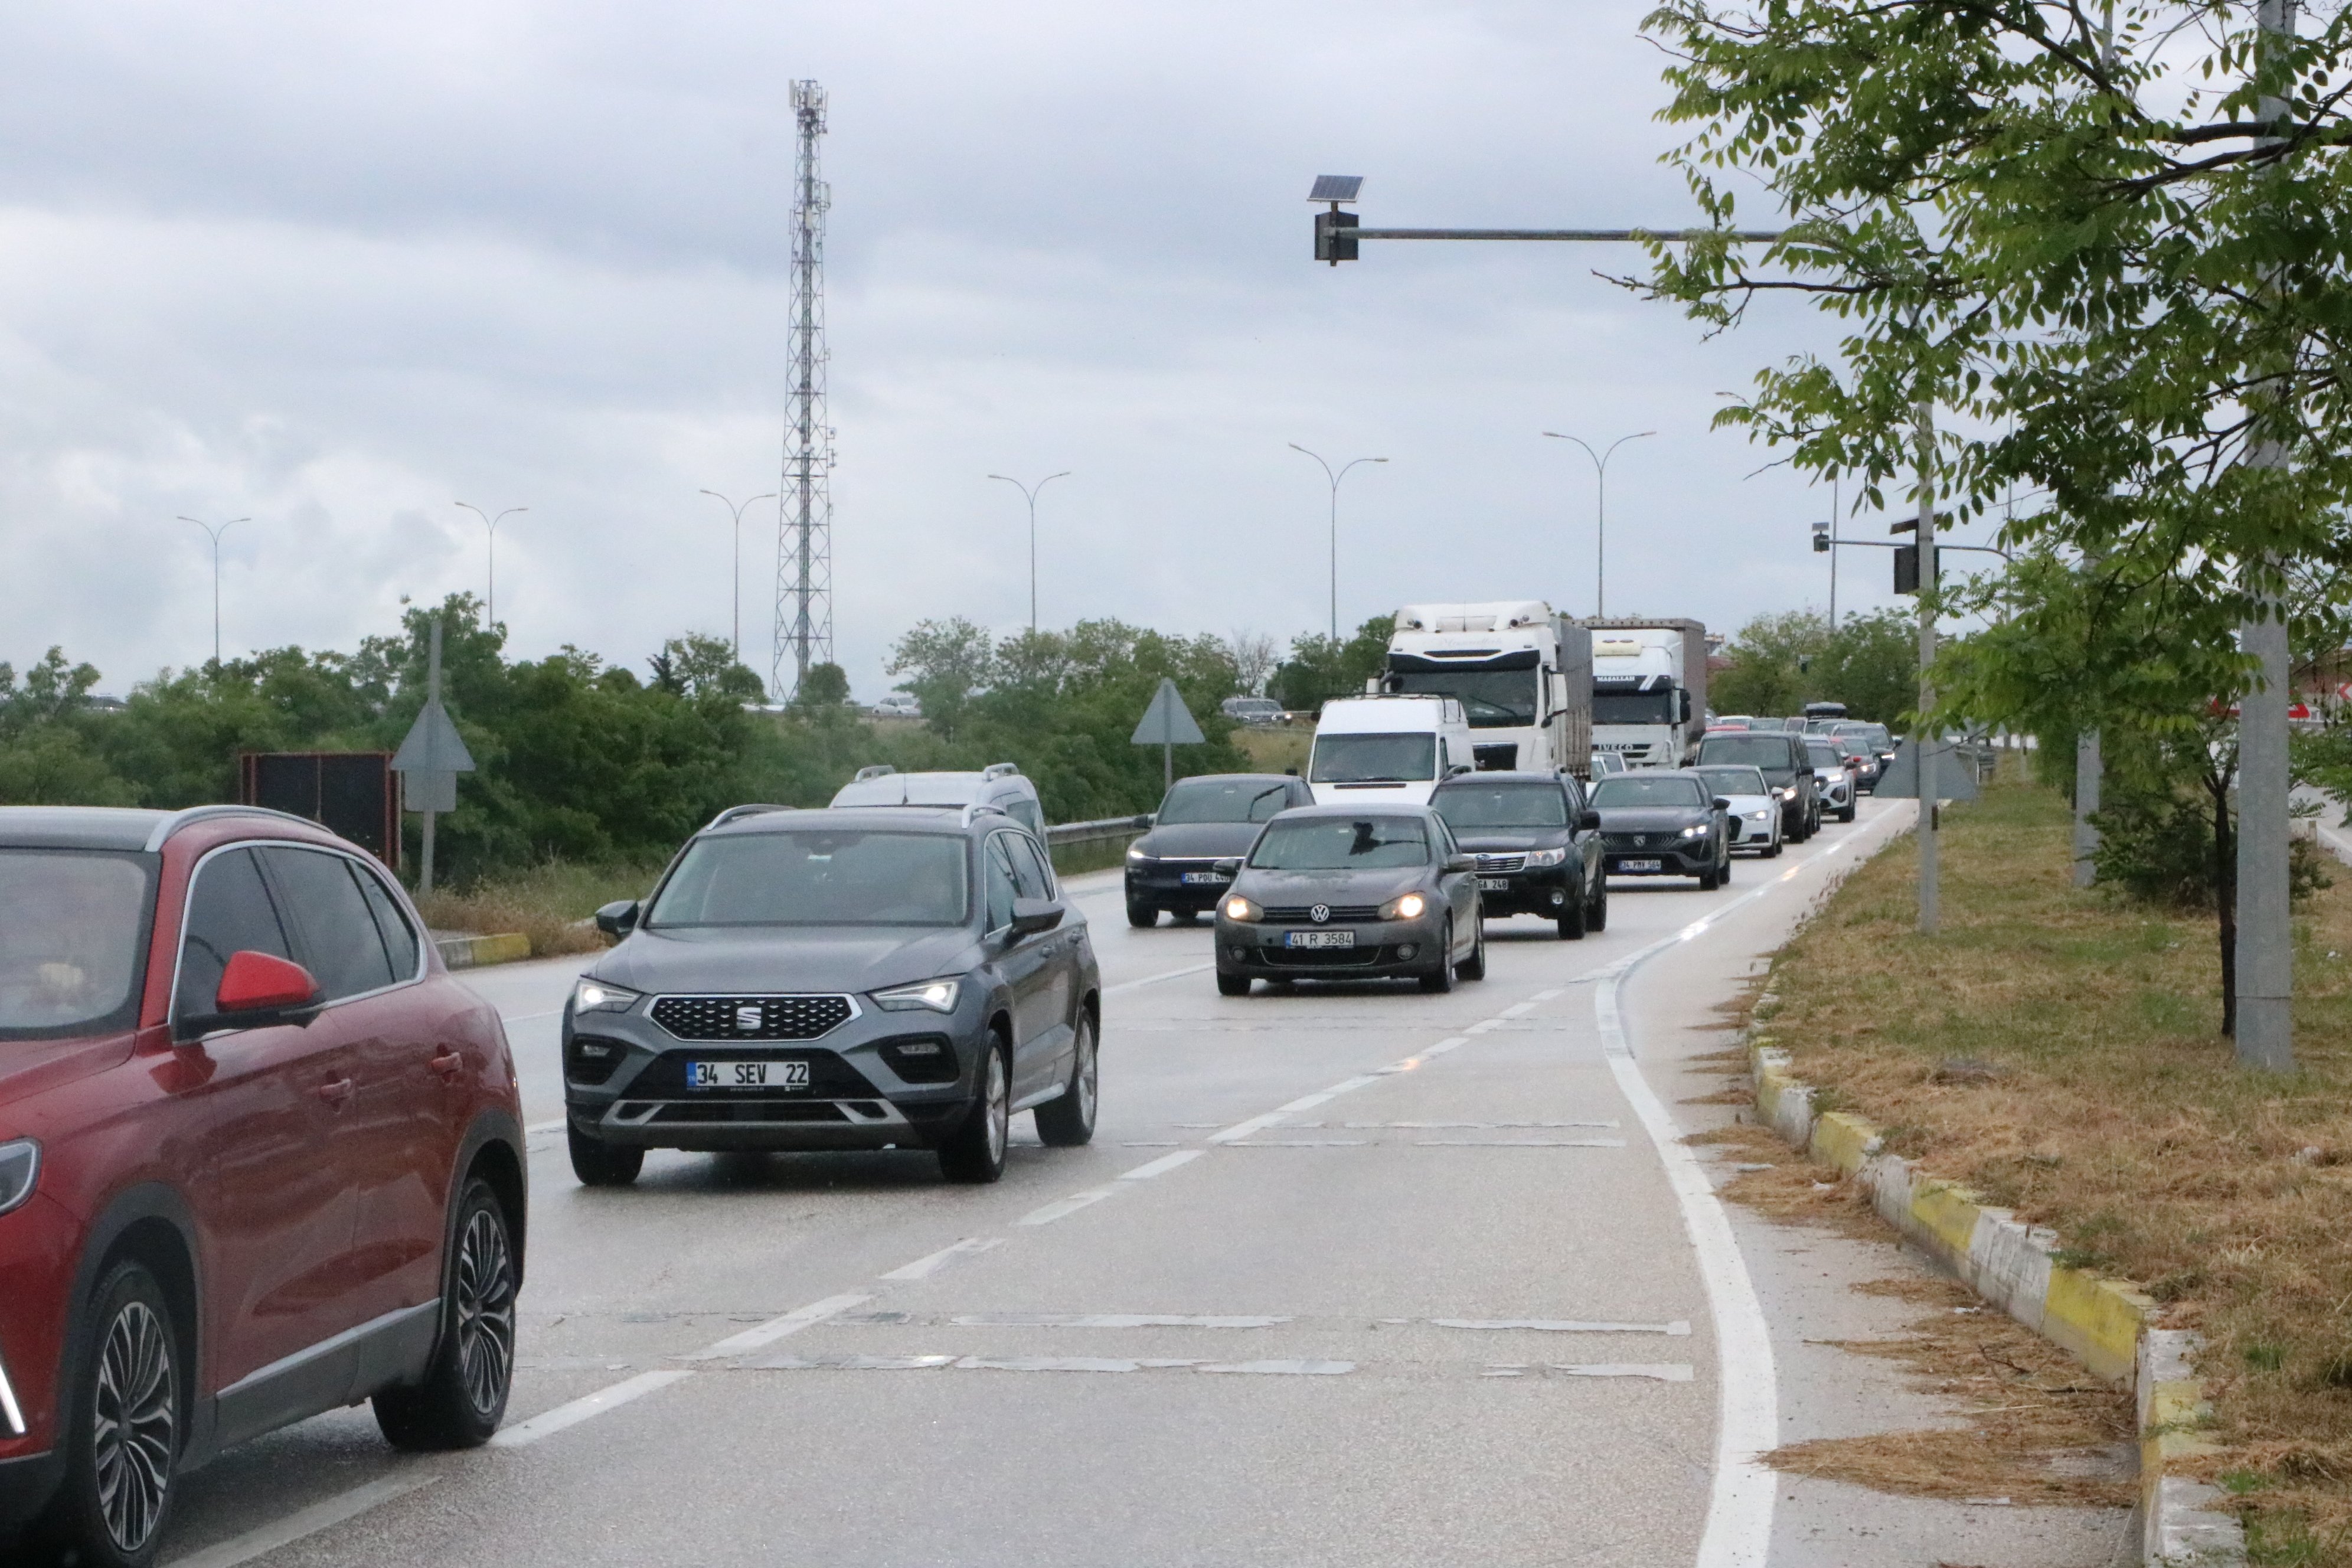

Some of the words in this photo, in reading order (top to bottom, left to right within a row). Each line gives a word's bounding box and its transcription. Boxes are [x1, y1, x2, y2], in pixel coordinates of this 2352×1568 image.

[1185, 874, 1194, 882] 34
[1492, 880, 1507, 888] 248
[1292, 934, 1302, 945] 41
[1309, 934, 1318, 945] R
[1324, 933, 1351, 944] 3584
[697, 1064, 718, 1084] 34
[735, 1064, 766, 1084] SEV
[786, 1064, 807, 1084] 22
